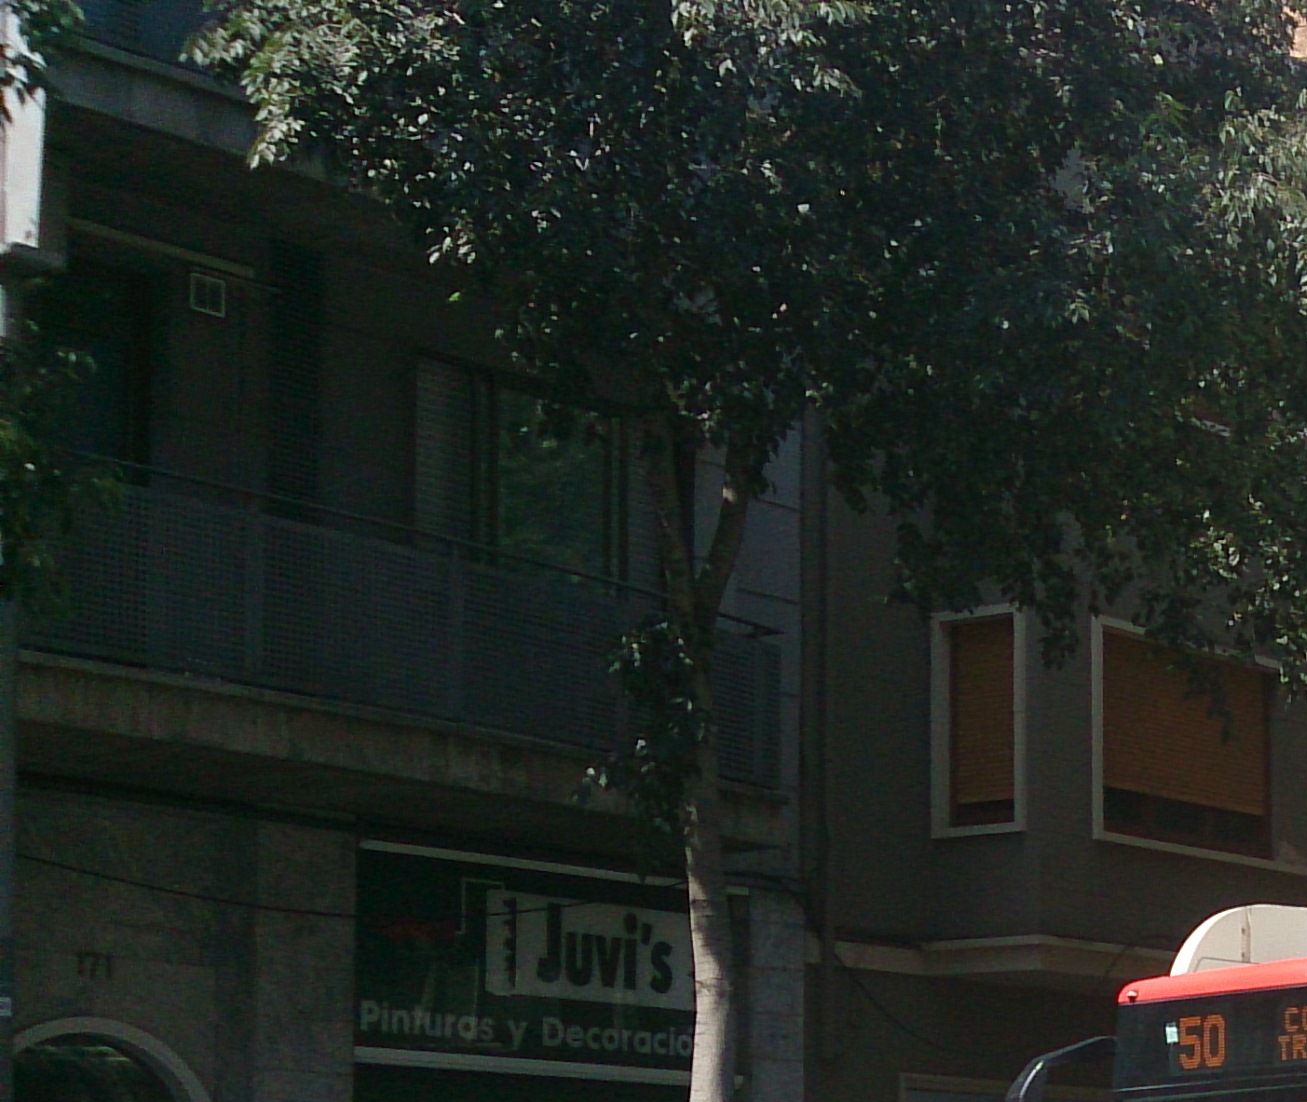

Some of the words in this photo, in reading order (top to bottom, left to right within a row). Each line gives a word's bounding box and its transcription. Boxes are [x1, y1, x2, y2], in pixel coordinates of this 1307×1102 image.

[360, 1000, 495, 1041] Pinturas
[507, 1018, 528, 1050] y
[1179, 1014, 1227, 1070] 50
